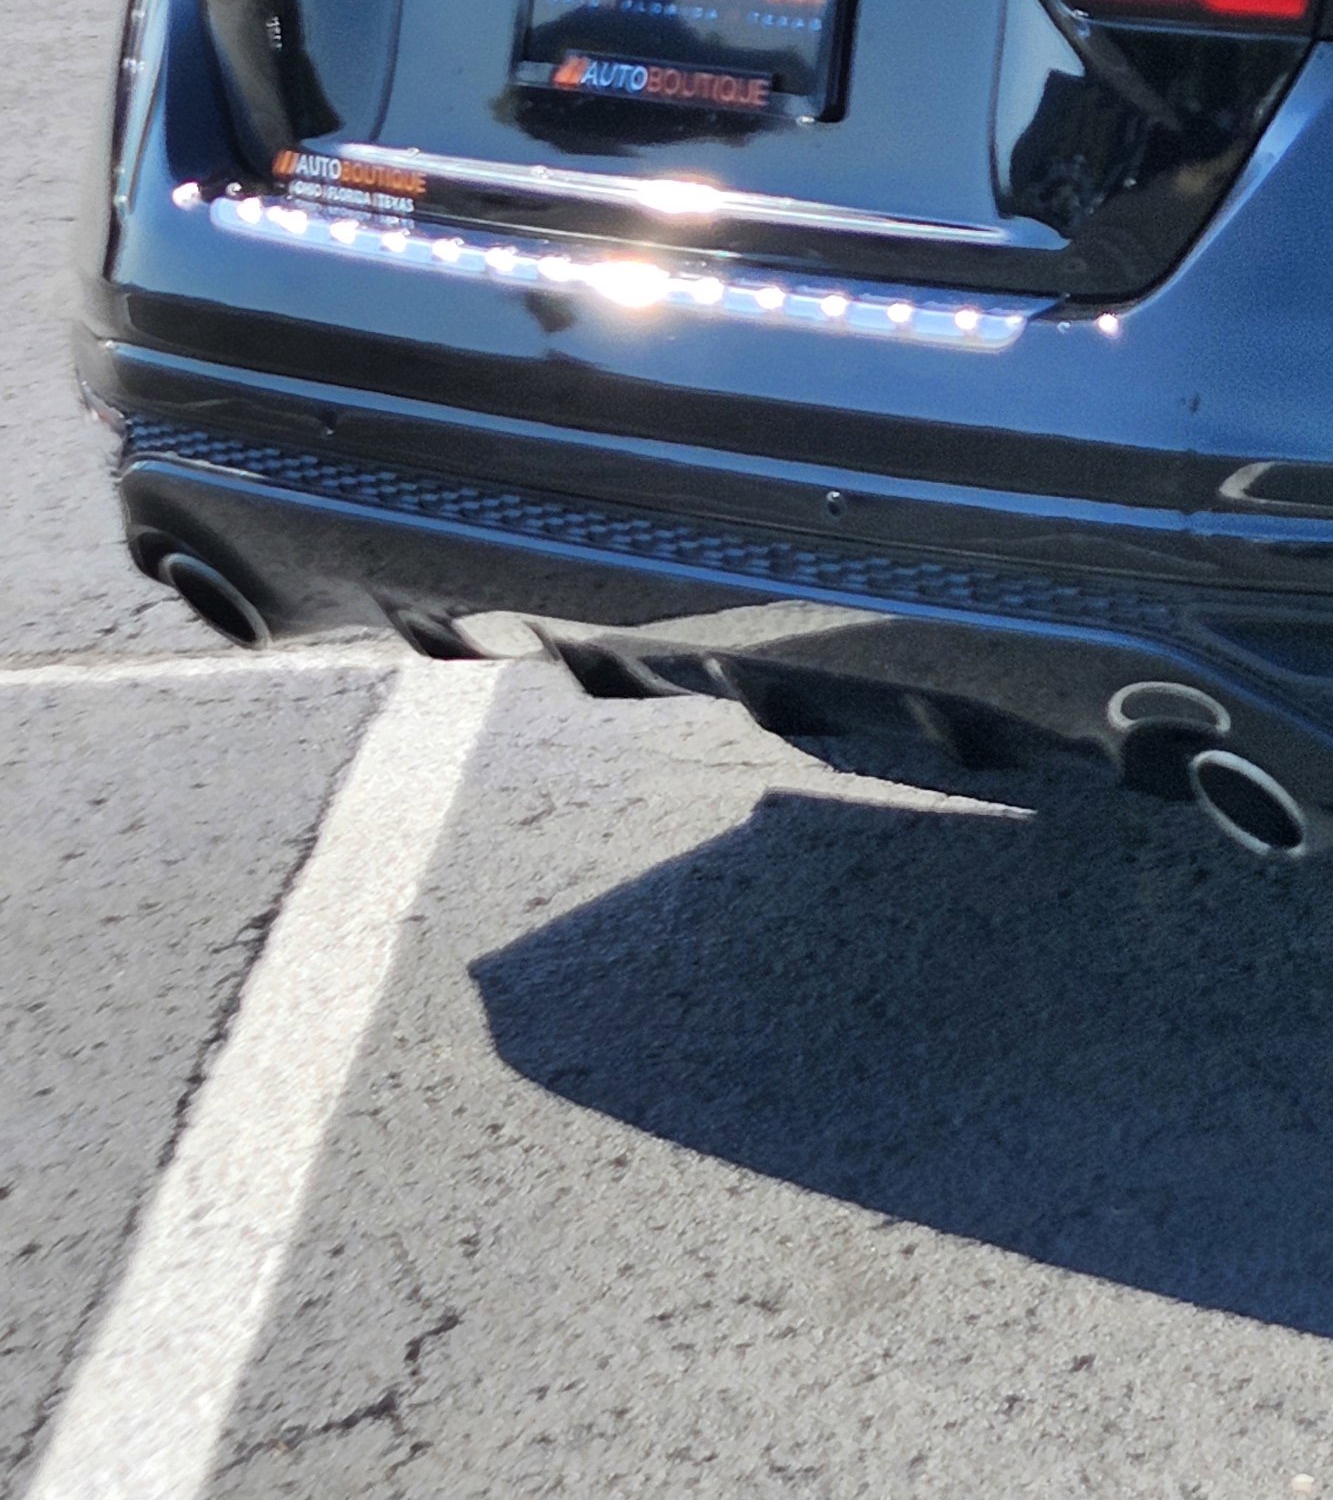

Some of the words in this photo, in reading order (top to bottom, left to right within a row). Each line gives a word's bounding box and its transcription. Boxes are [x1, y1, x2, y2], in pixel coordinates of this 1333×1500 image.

[580, 60, 771, 107] AUTOBOUTIQUE
[295, 154, 427, 195] AUTOBOUTIQUE
[377, 192, 415, 213] TEXAS
